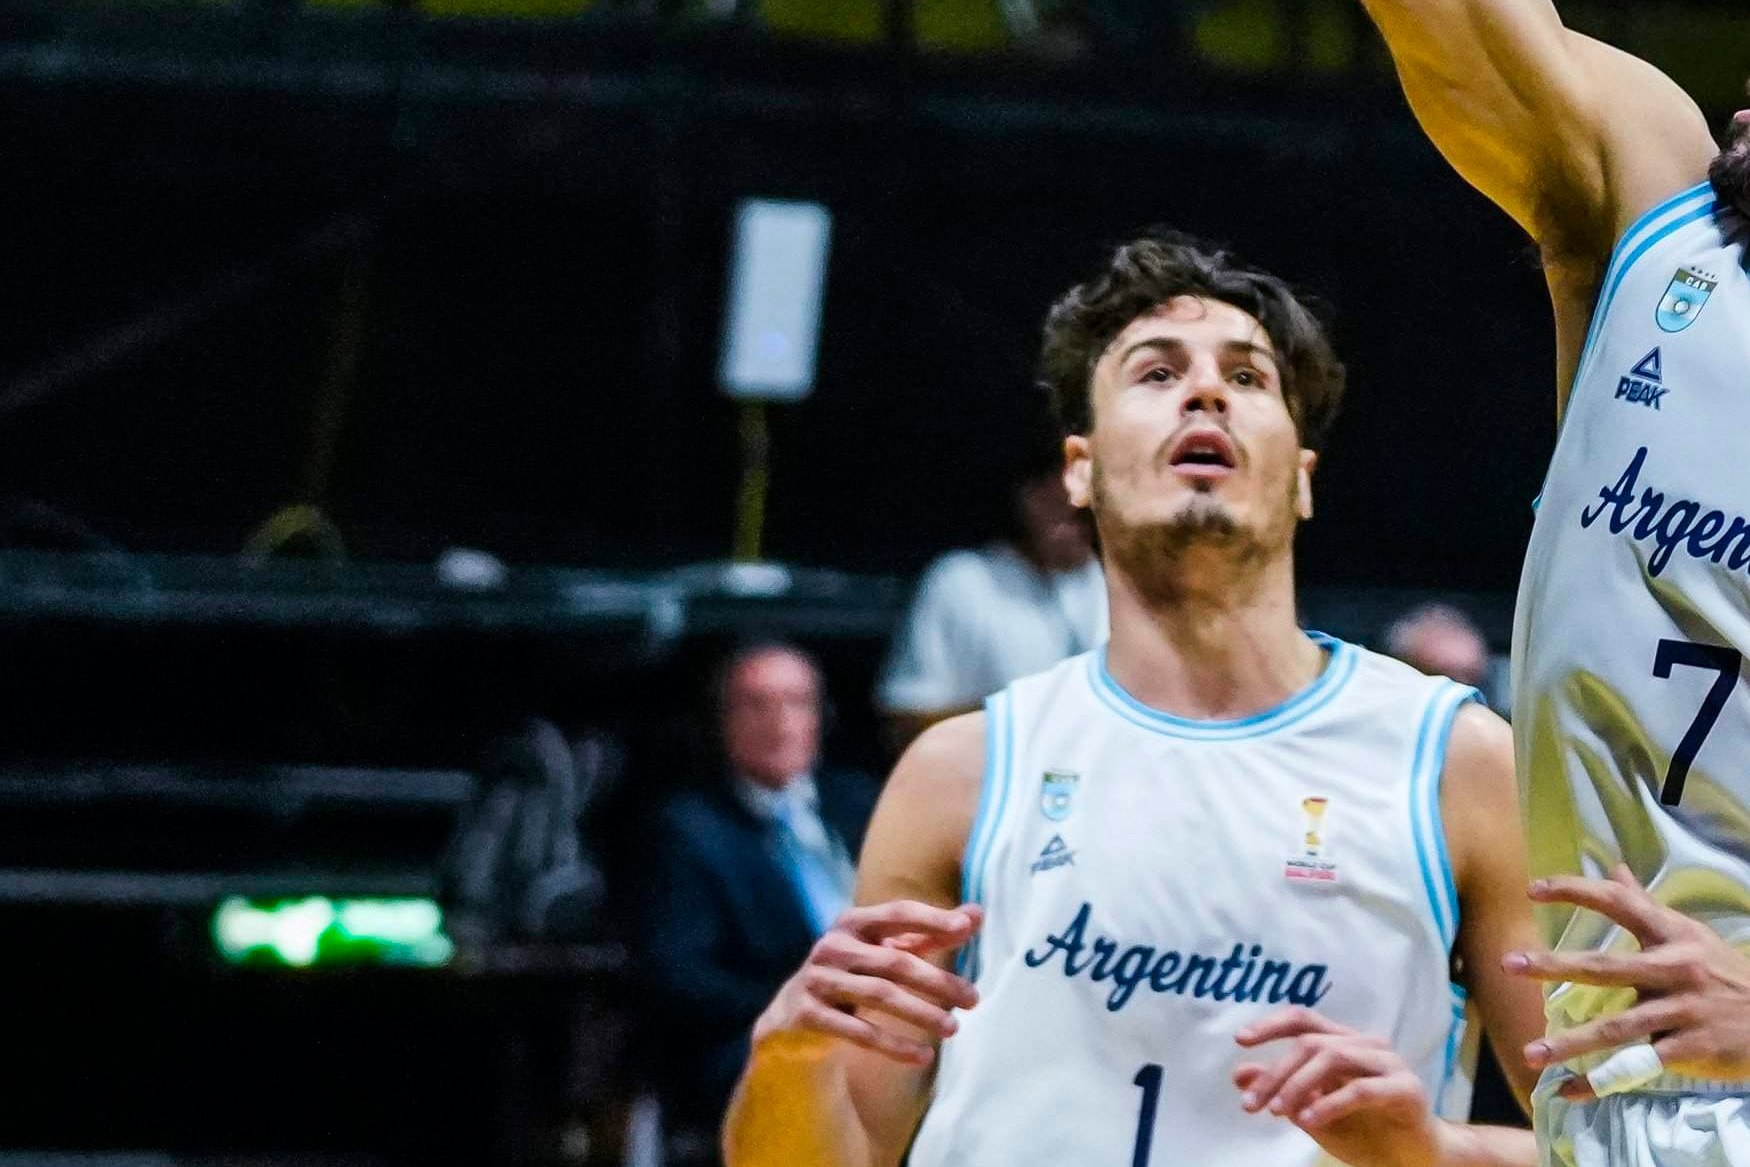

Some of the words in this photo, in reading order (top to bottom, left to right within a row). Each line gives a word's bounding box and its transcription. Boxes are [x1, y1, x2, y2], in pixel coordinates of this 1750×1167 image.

[1614, 375, 1670, 411] PEAK
[1651, 638, 1743, 807] 7
[1024, 901, 1334, 1012] Argentina
[1132, 1063, 1164, 1167] 1
